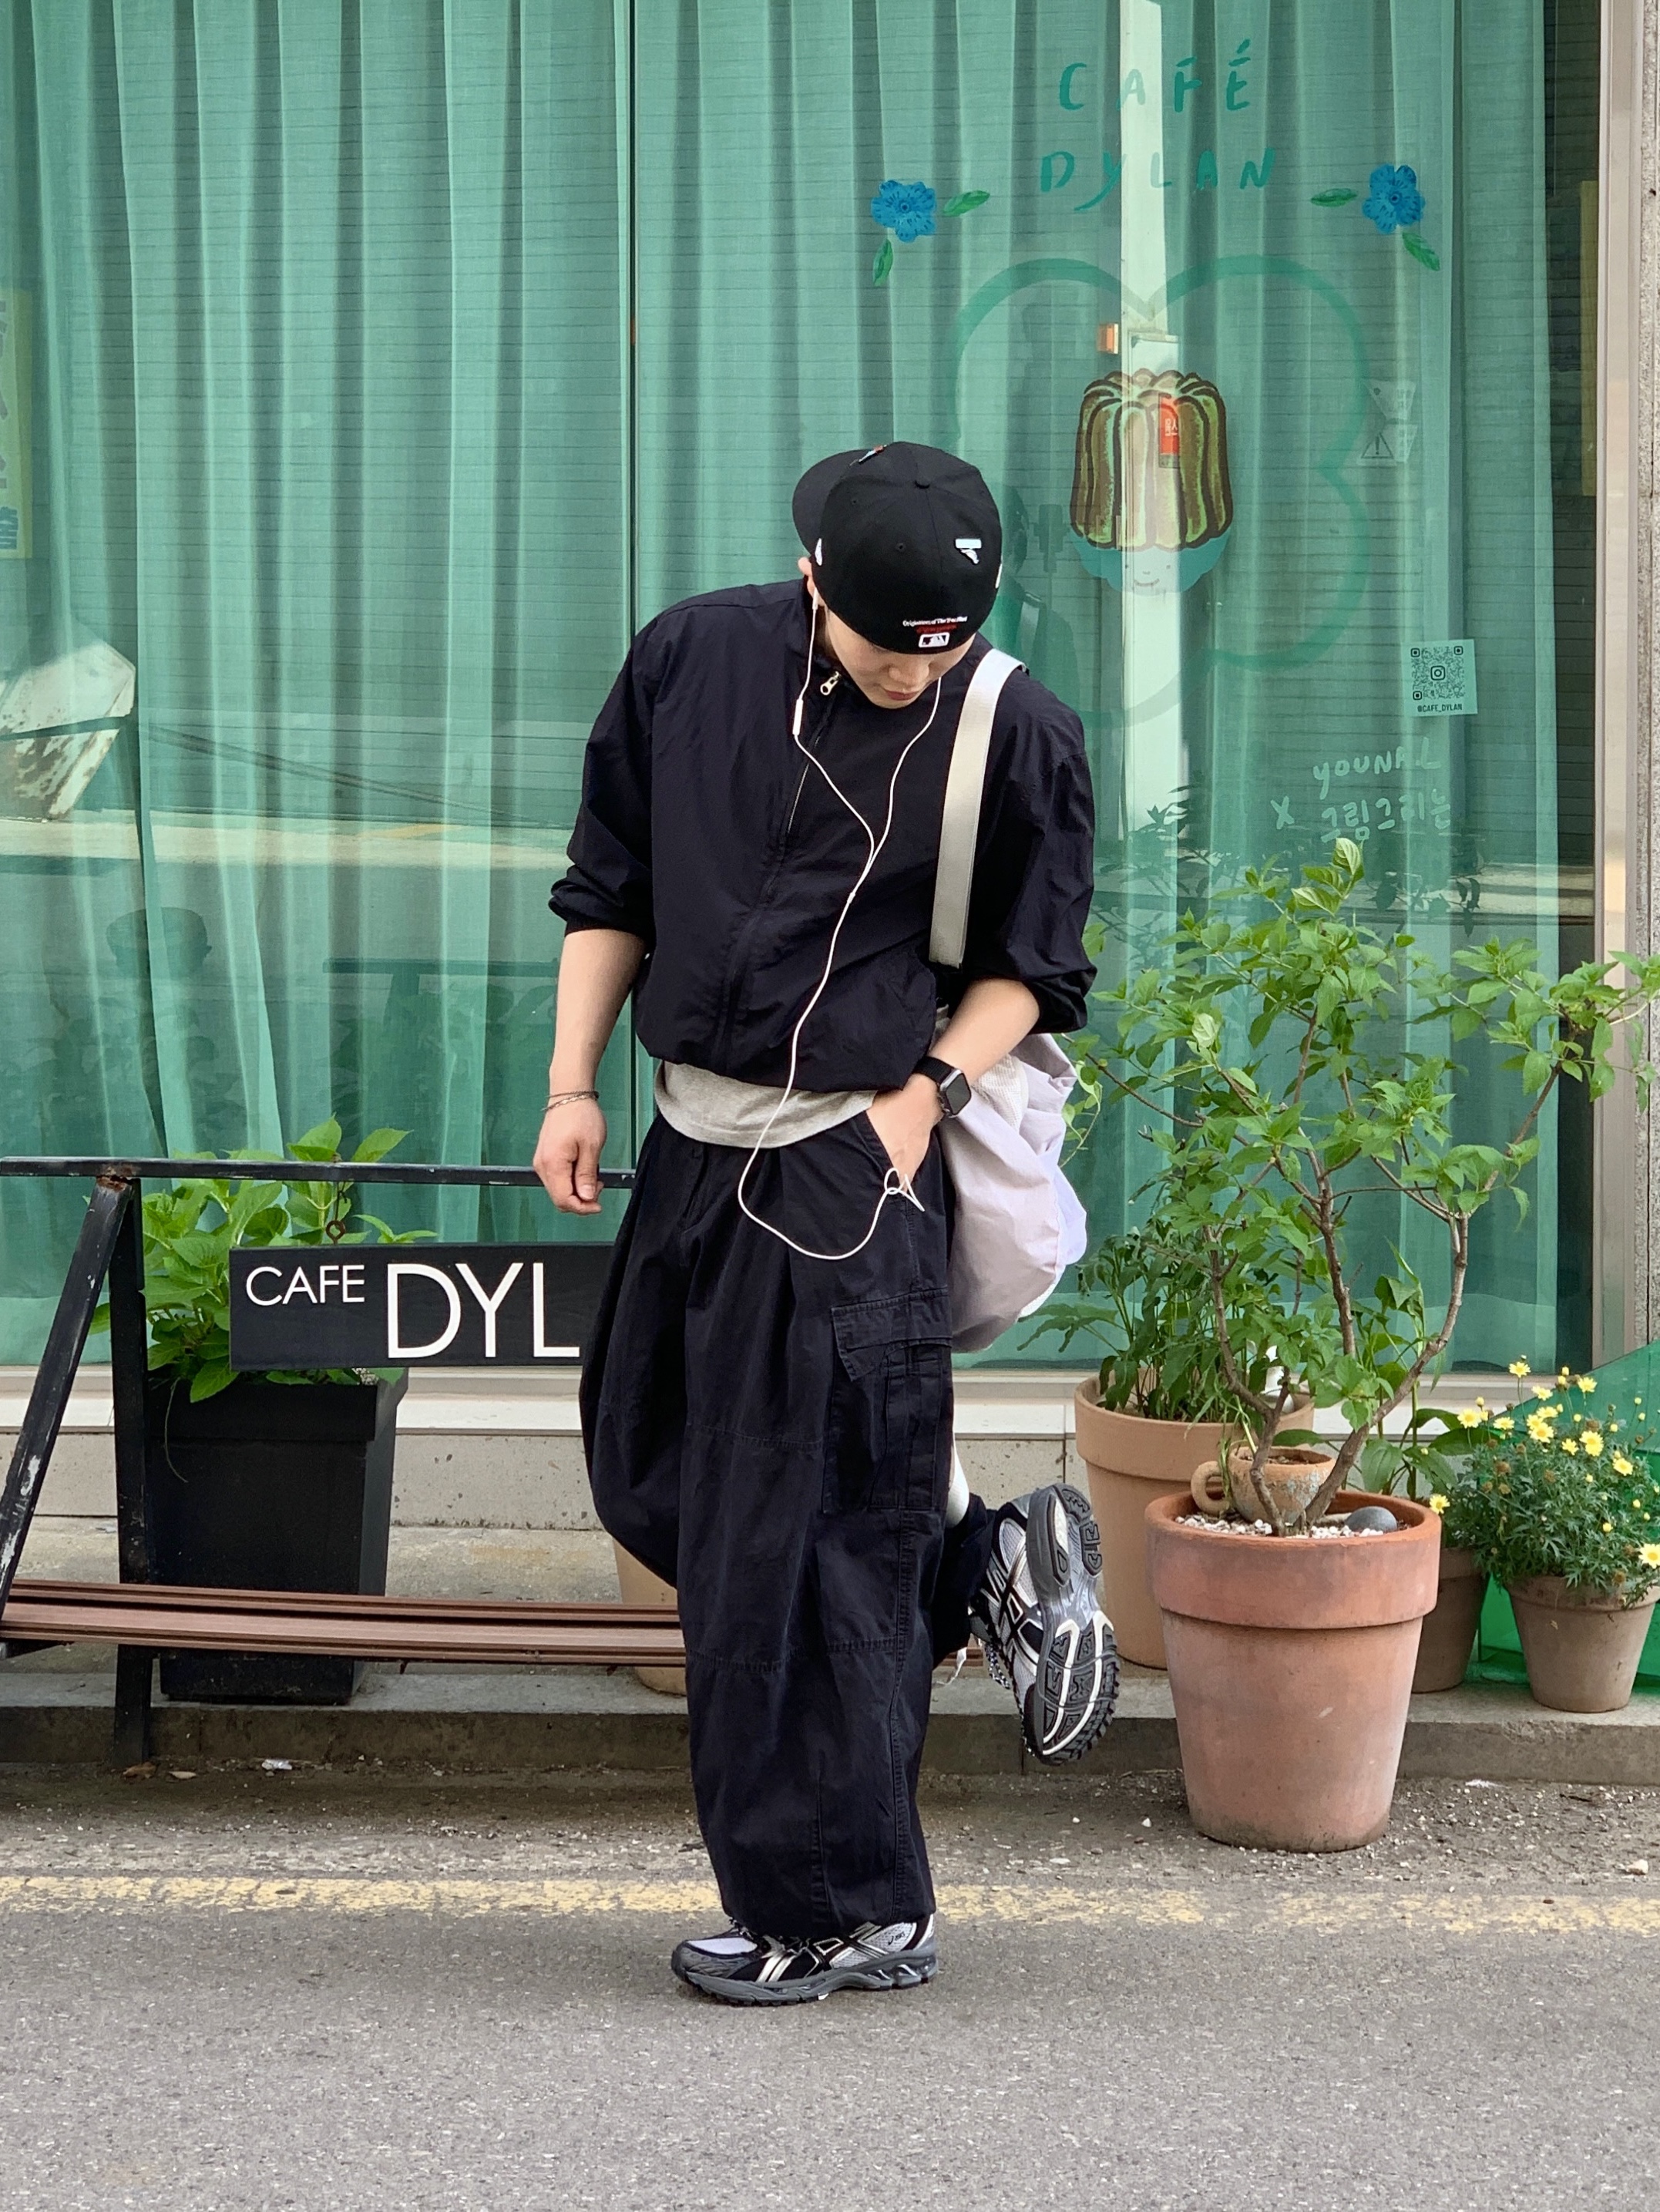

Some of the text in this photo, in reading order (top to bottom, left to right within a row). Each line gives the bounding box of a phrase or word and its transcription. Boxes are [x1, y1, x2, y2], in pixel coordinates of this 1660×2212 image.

[1059, 39, 1251, 113] CAFÉ
[1040, 147, 1276, 211] DYLAN
[1416, 703, 1463, 713] @CAFE_DYLAN
[245, 1262, 580, 1359] CAFE DYL
